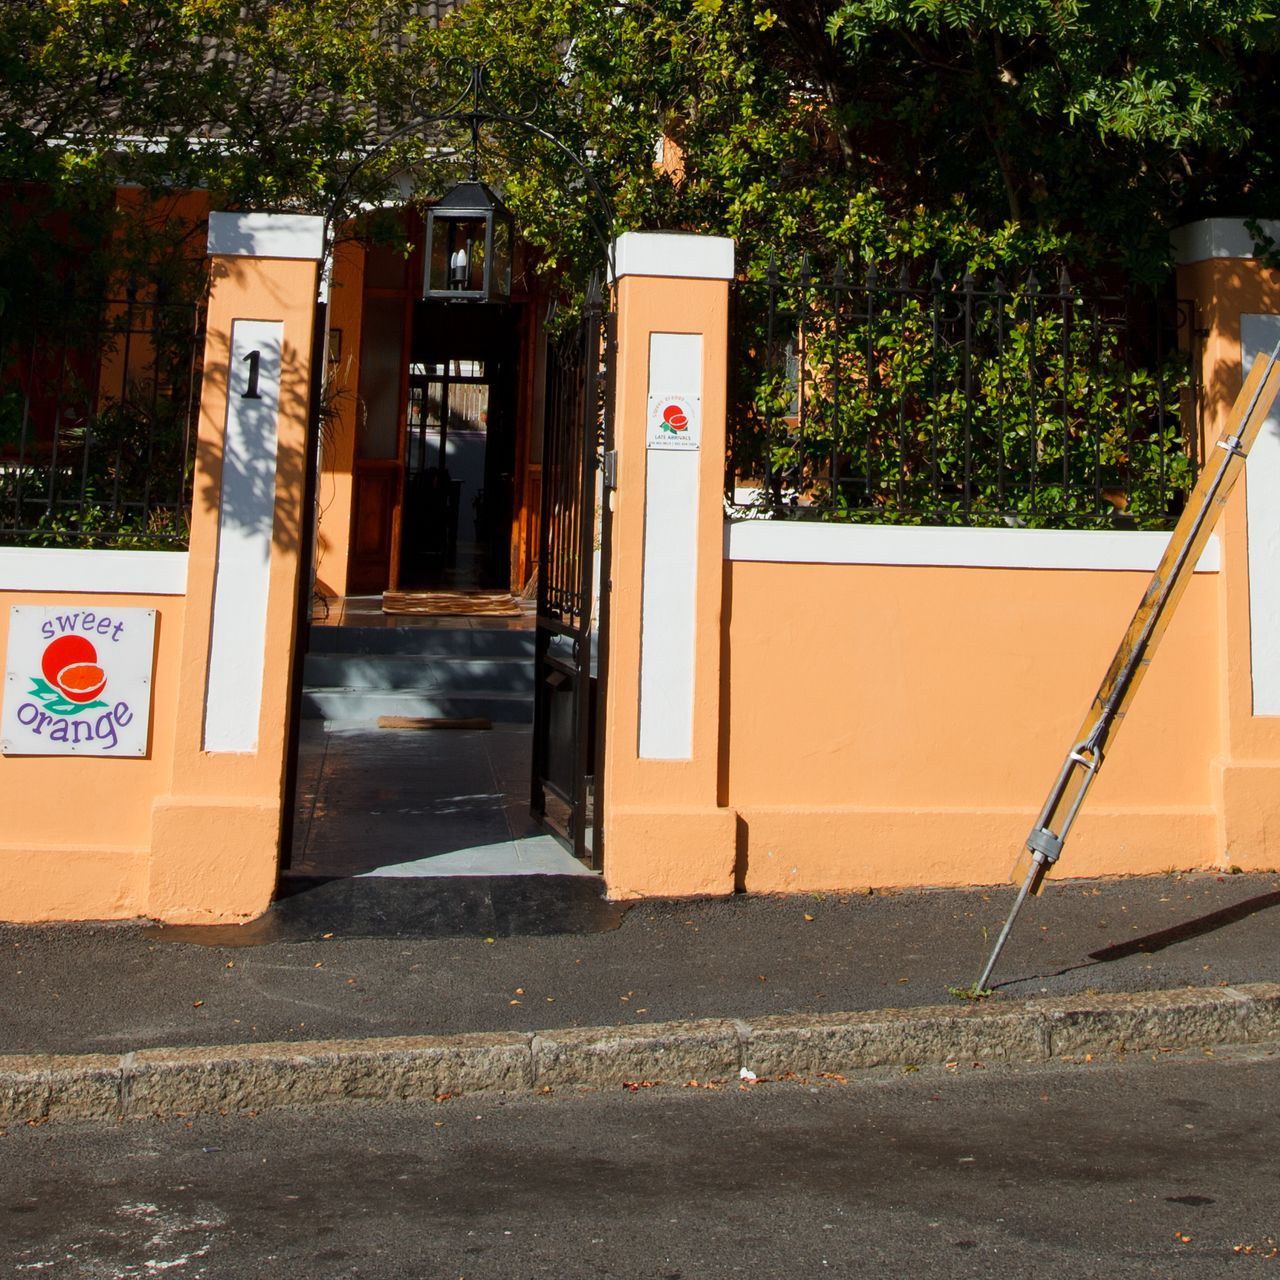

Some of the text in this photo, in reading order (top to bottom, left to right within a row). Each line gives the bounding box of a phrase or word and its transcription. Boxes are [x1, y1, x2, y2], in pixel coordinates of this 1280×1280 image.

[241, 350, 262, 399] 1
[41, 612, 124, 642] sweet
[17, 701, 133, 750] orange
